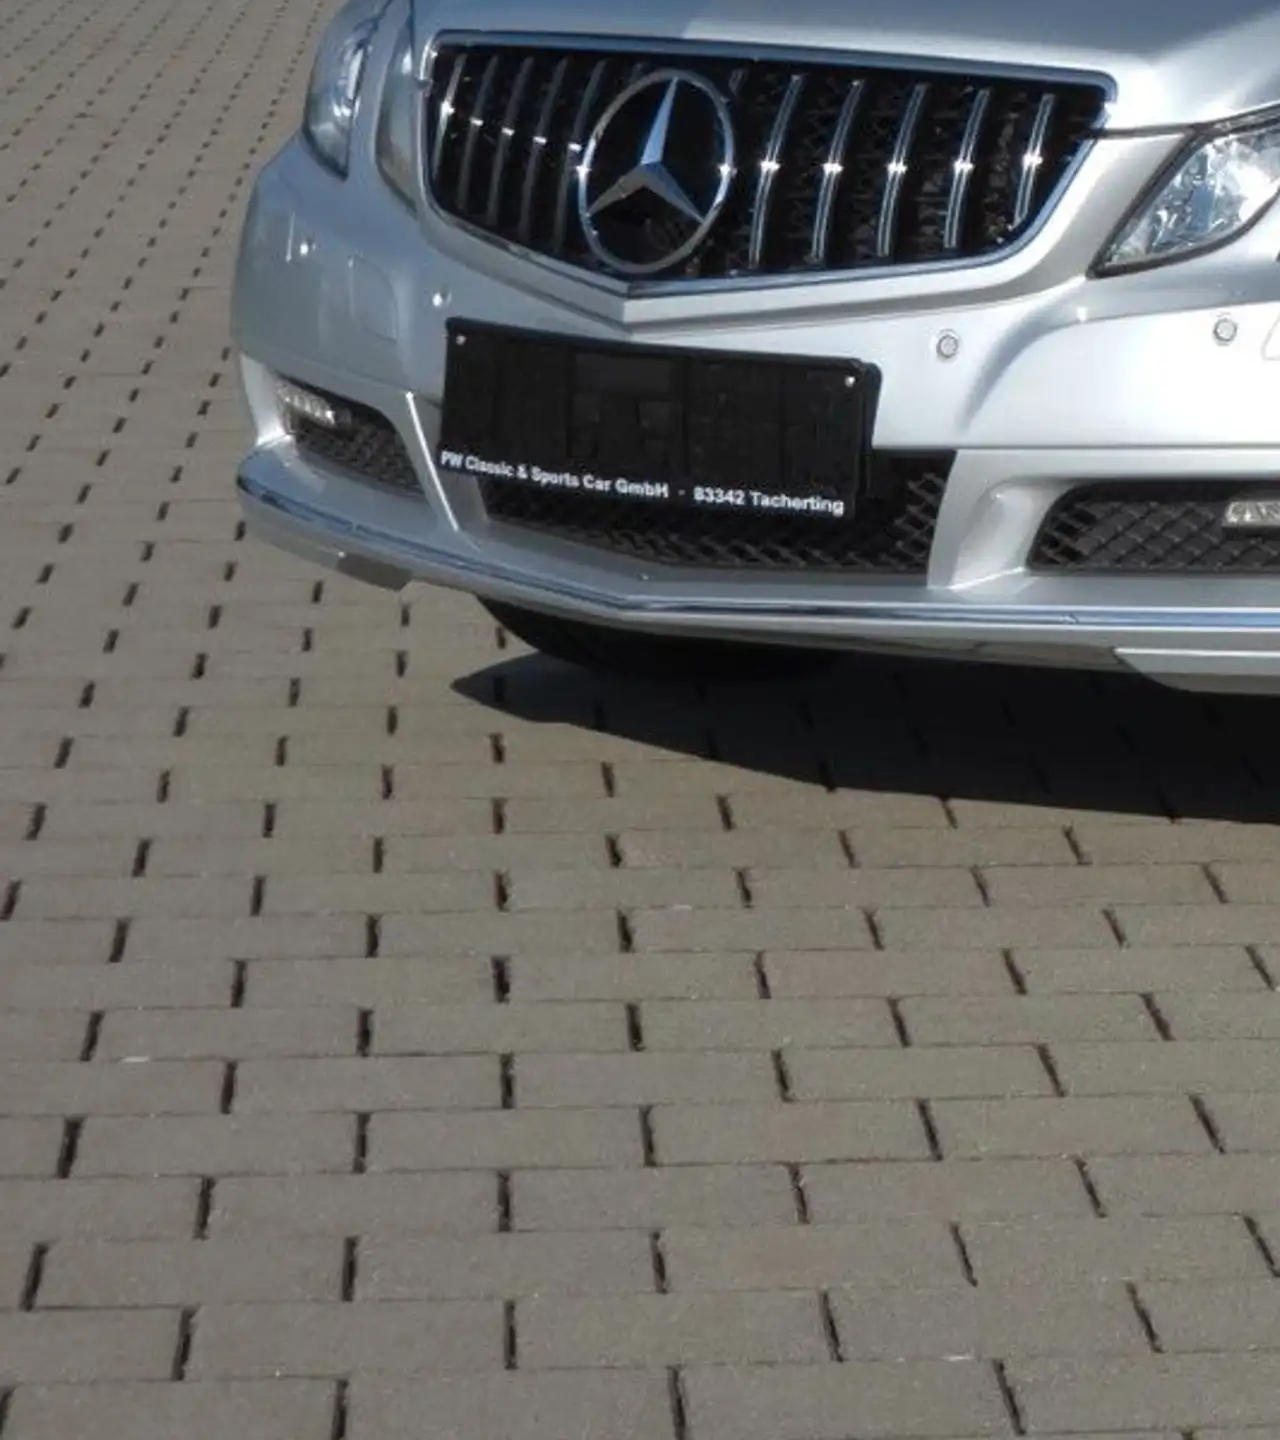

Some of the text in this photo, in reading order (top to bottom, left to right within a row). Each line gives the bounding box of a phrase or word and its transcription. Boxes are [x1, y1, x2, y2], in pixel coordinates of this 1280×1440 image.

[465, 455, 515, 477] Classic
[516, 463, 528, 479] &
[531, 466, 580, 487] Sports
[582, 473, 612, 492] Car
[614, 477, 669, 498] GmbH
[693, 486, 746, 505] 83342
[750, 490, 845, 517] Tacherting
